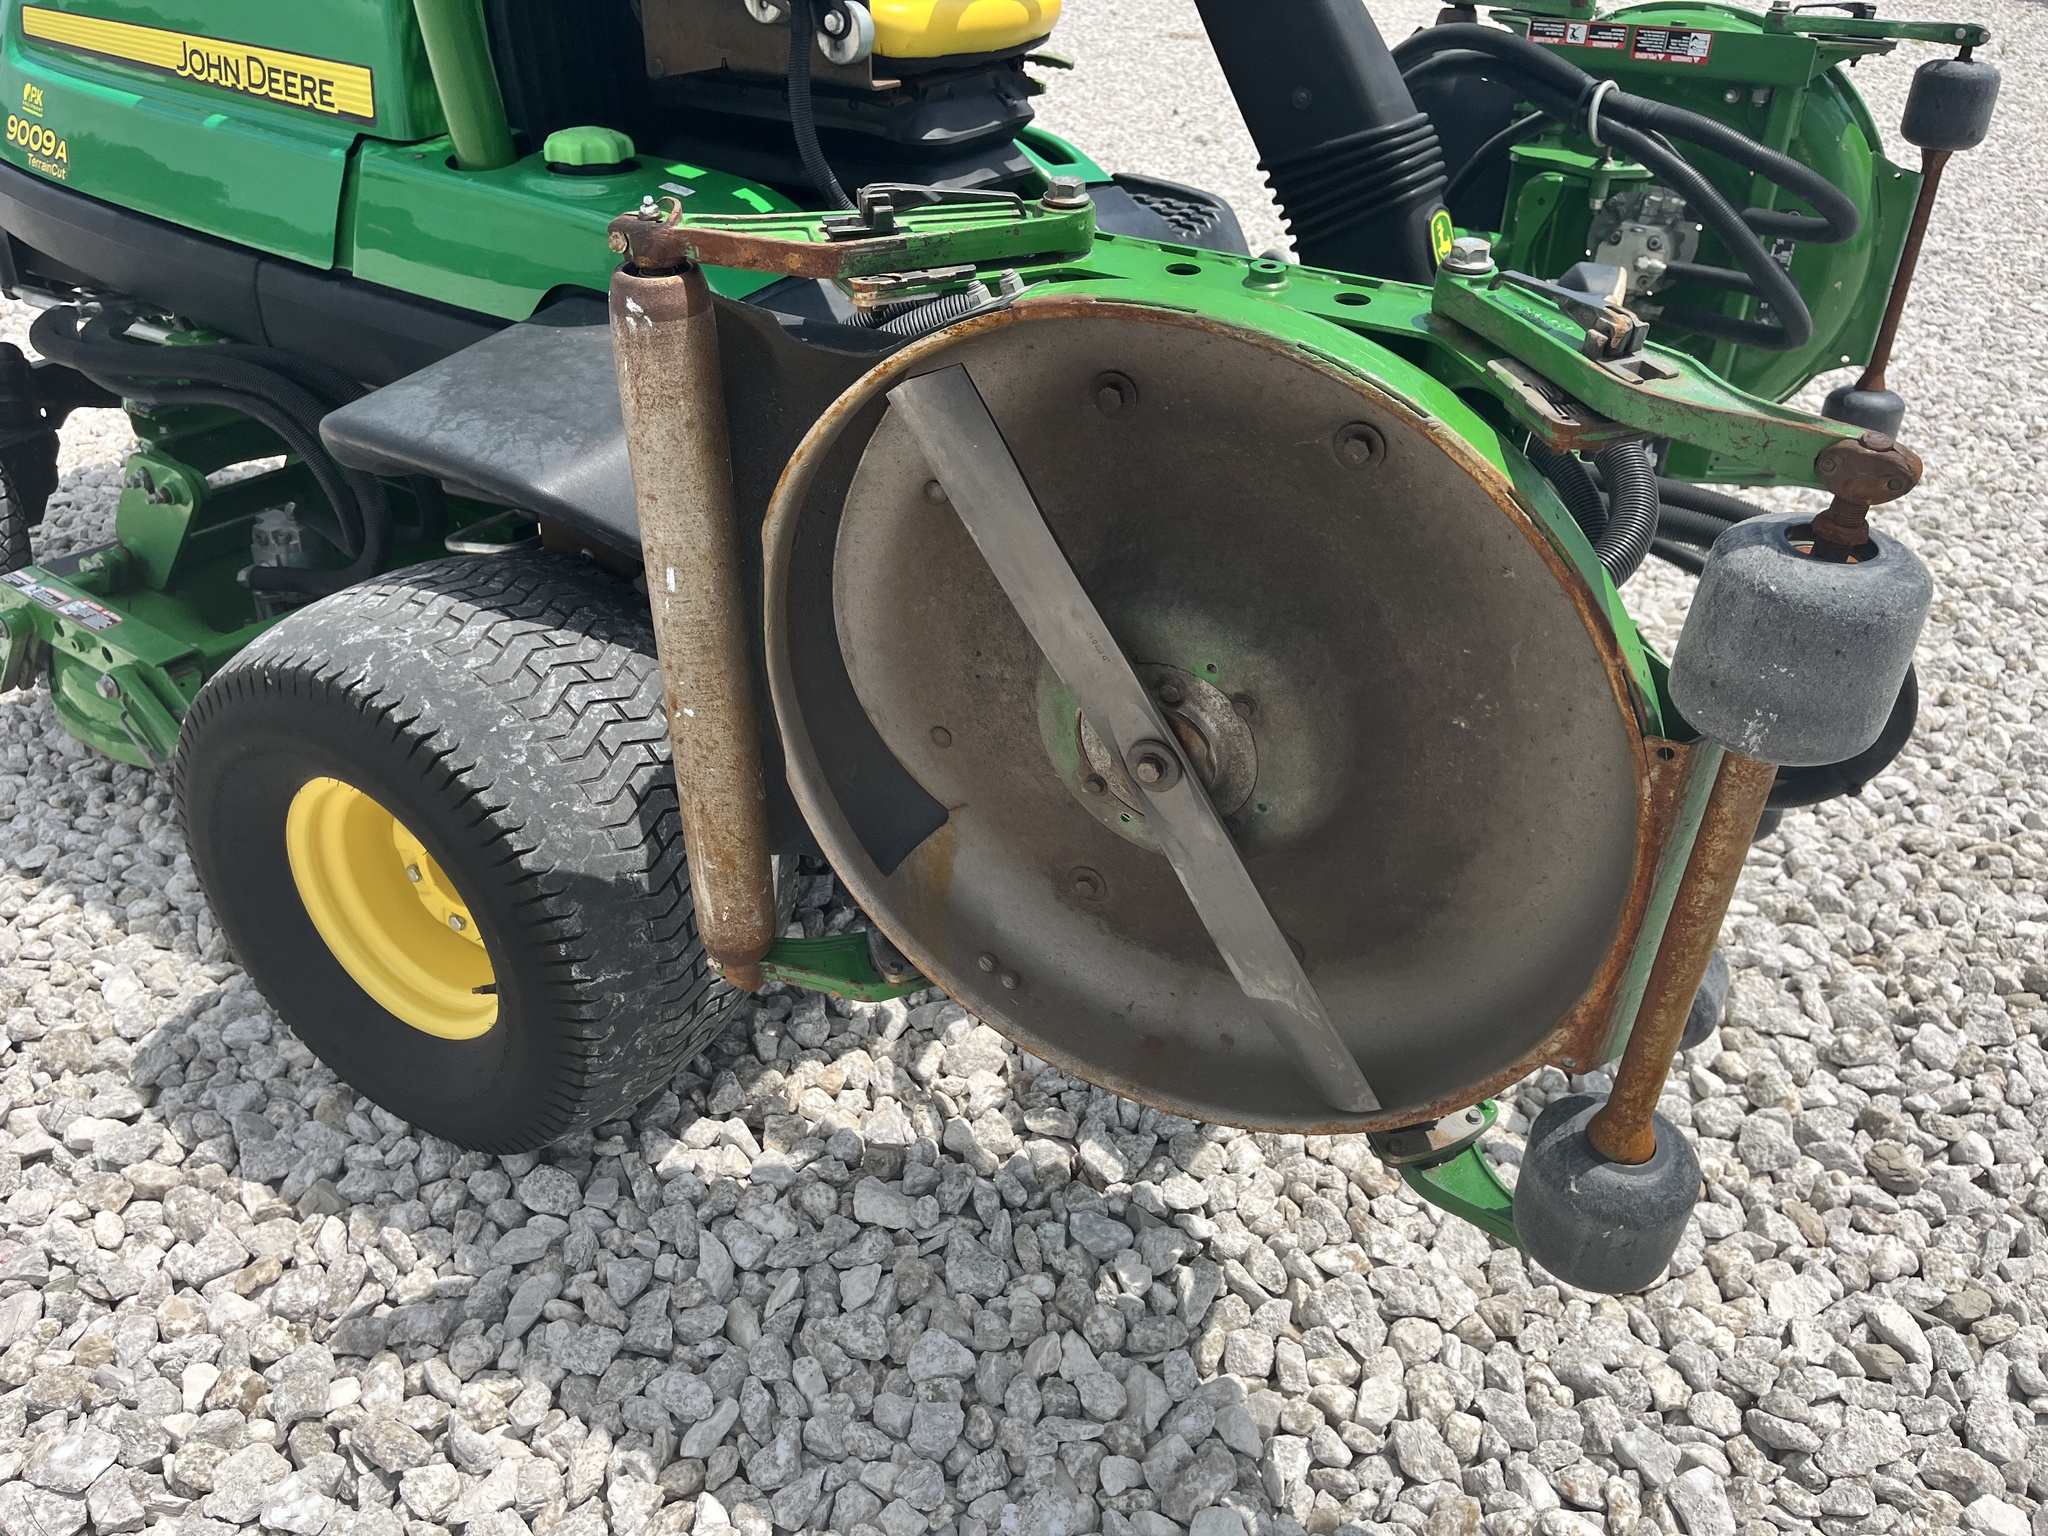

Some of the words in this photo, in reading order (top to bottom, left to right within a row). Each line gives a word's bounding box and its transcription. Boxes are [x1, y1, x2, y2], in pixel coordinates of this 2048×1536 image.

[176, 40, 242, 87] JOHN
[246, 55, 338, 112] DEERE
[6, 114, 67, 164] 9009A
[27, 153, 66, 180] TerrainCut
